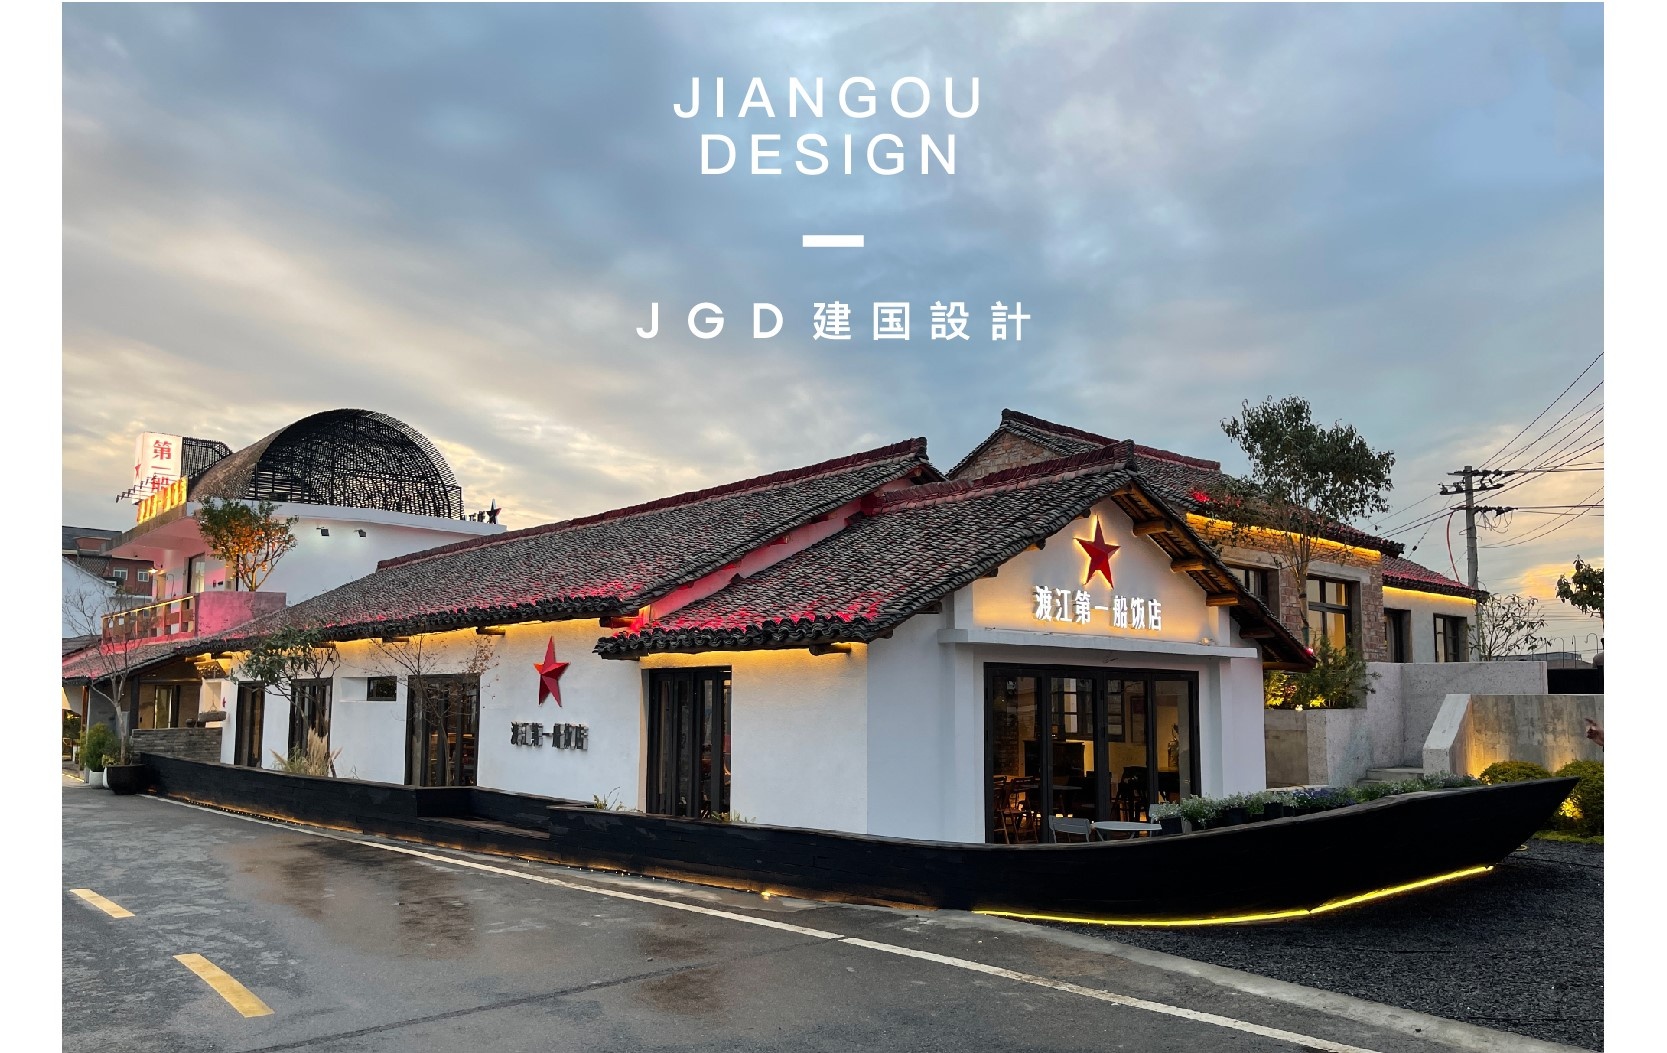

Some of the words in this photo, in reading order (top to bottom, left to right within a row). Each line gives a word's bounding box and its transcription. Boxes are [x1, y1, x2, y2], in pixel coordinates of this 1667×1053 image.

[1034, 585, 1162, 631] 渡江第一船饭店
